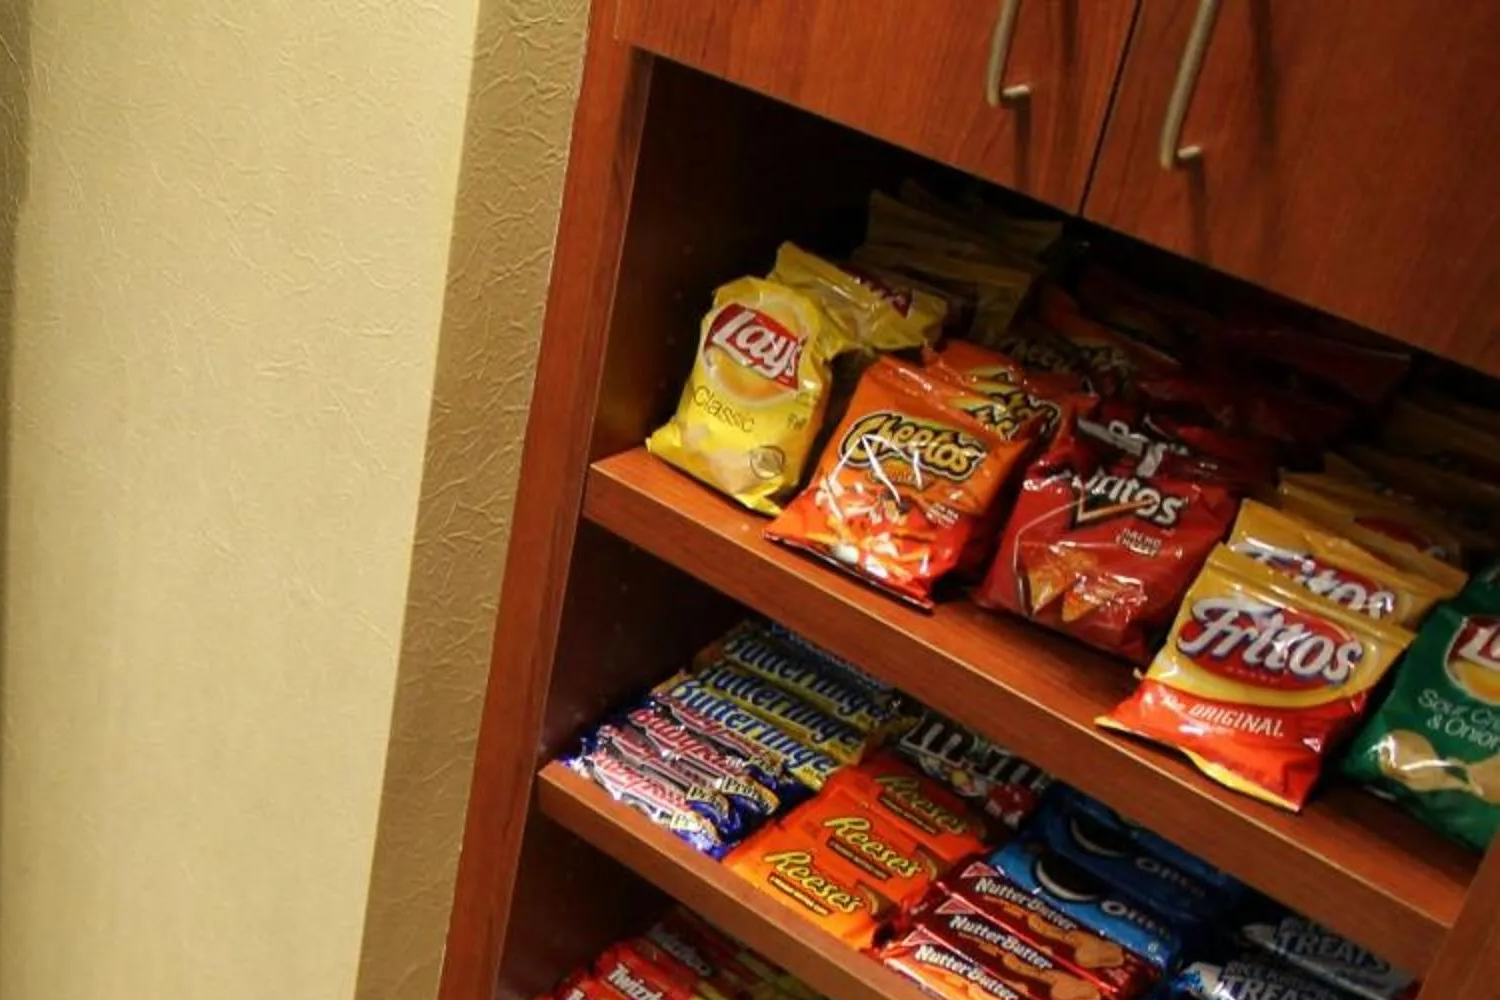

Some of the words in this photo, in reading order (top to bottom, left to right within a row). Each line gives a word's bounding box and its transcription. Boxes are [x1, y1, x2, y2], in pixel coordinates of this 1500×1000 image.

[841, 411, 978, 480] Cheetos
[1176, 597, 1365, 687] Fritos
[1188, 703, 1284, 737] ORIGINAL
[1418, 687, 1464, 718] Sour
[1426, 714, 1443, 732] &
[824, 817, 921, 878] Reese's
[765, 851, 864, 913] Reese's
